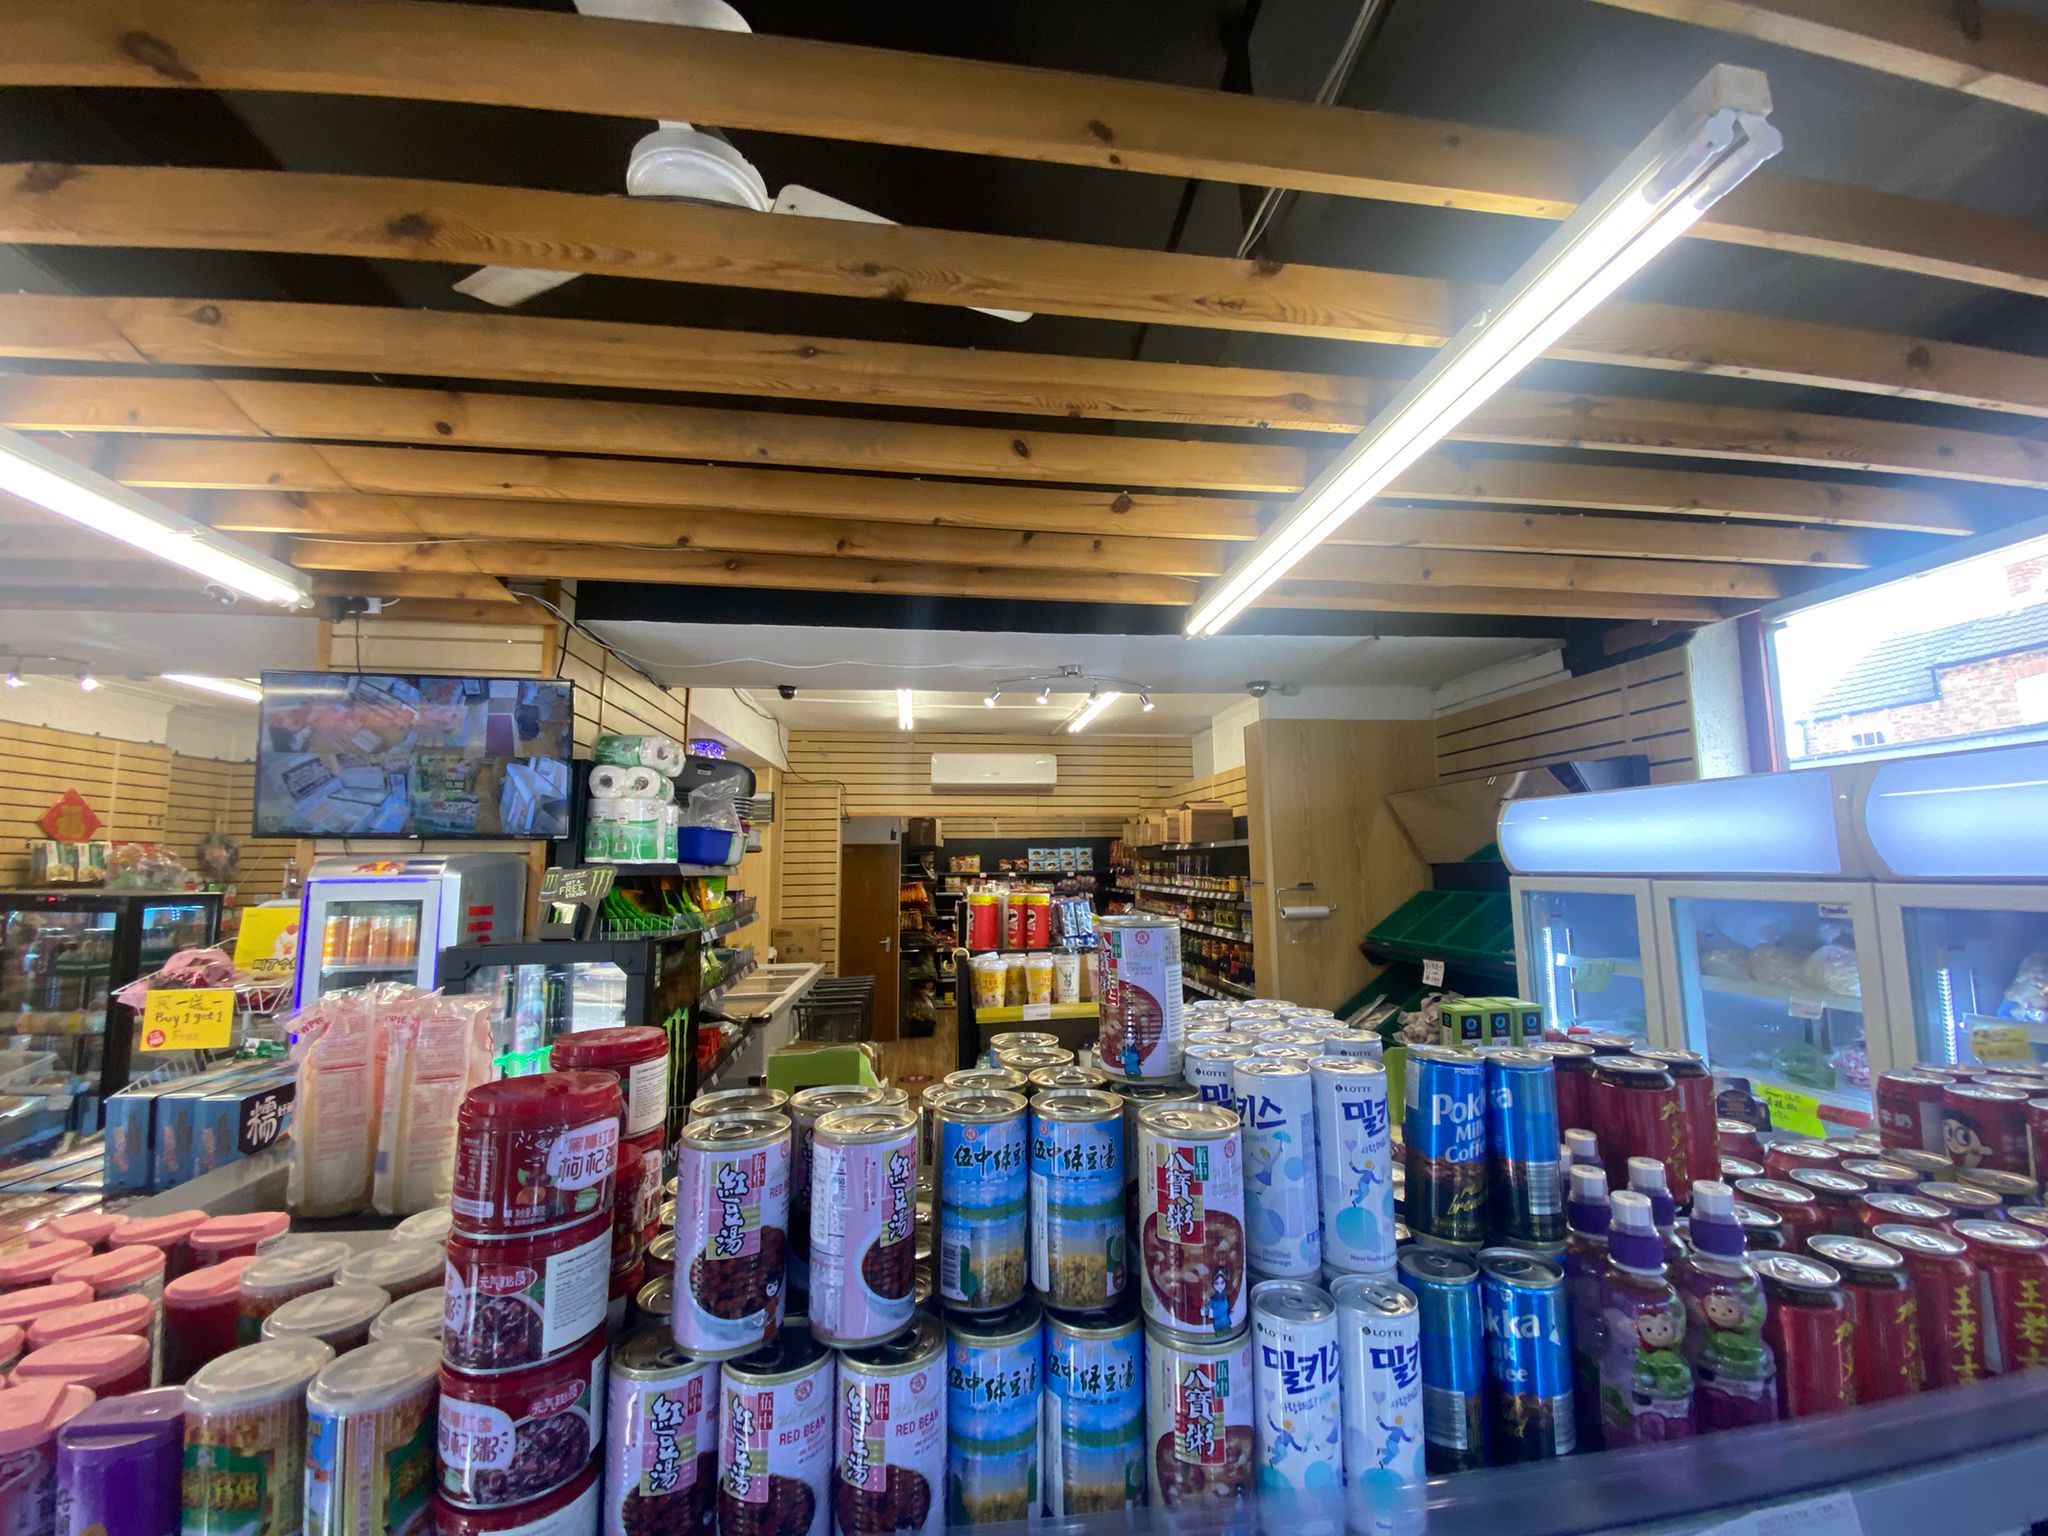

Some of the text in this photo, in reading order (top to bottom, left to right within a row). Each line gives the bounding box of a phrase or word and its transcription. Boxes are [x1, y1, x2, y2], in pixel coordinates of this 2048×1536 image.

[559, 883, 585, 895] FREE
[155, 1012, 181, 1028] Buy
[193, 1012, 214, 1025] get
[1202, 1070, 1227, 1078] LOTTE
[1345, 1085, 1373, 1093] LOTTE
[1164, 1151, 1195, 1236] 八寶粥
[715, 1163, 749, 1256] 紅豆湯
[1264, 1328, 1295, 1343] LOTE
[1373, 1329, 1403, 1338] LOTTE
[1217, 1361, 1229, 1397] 伍中
[758, 1392, 773, 1430] 伍中
[874, 1383, 889, 1420] 伍中
[1183, 1368, 1216, 1456] 八寶粥
[779, 1415, 826, 1446] RED BEAN
[895, 1419, 916, 1437] RED
[918, 1408, 940, 1430] BEAN
[650, 1393, 685, 1492] 紅豆湯
